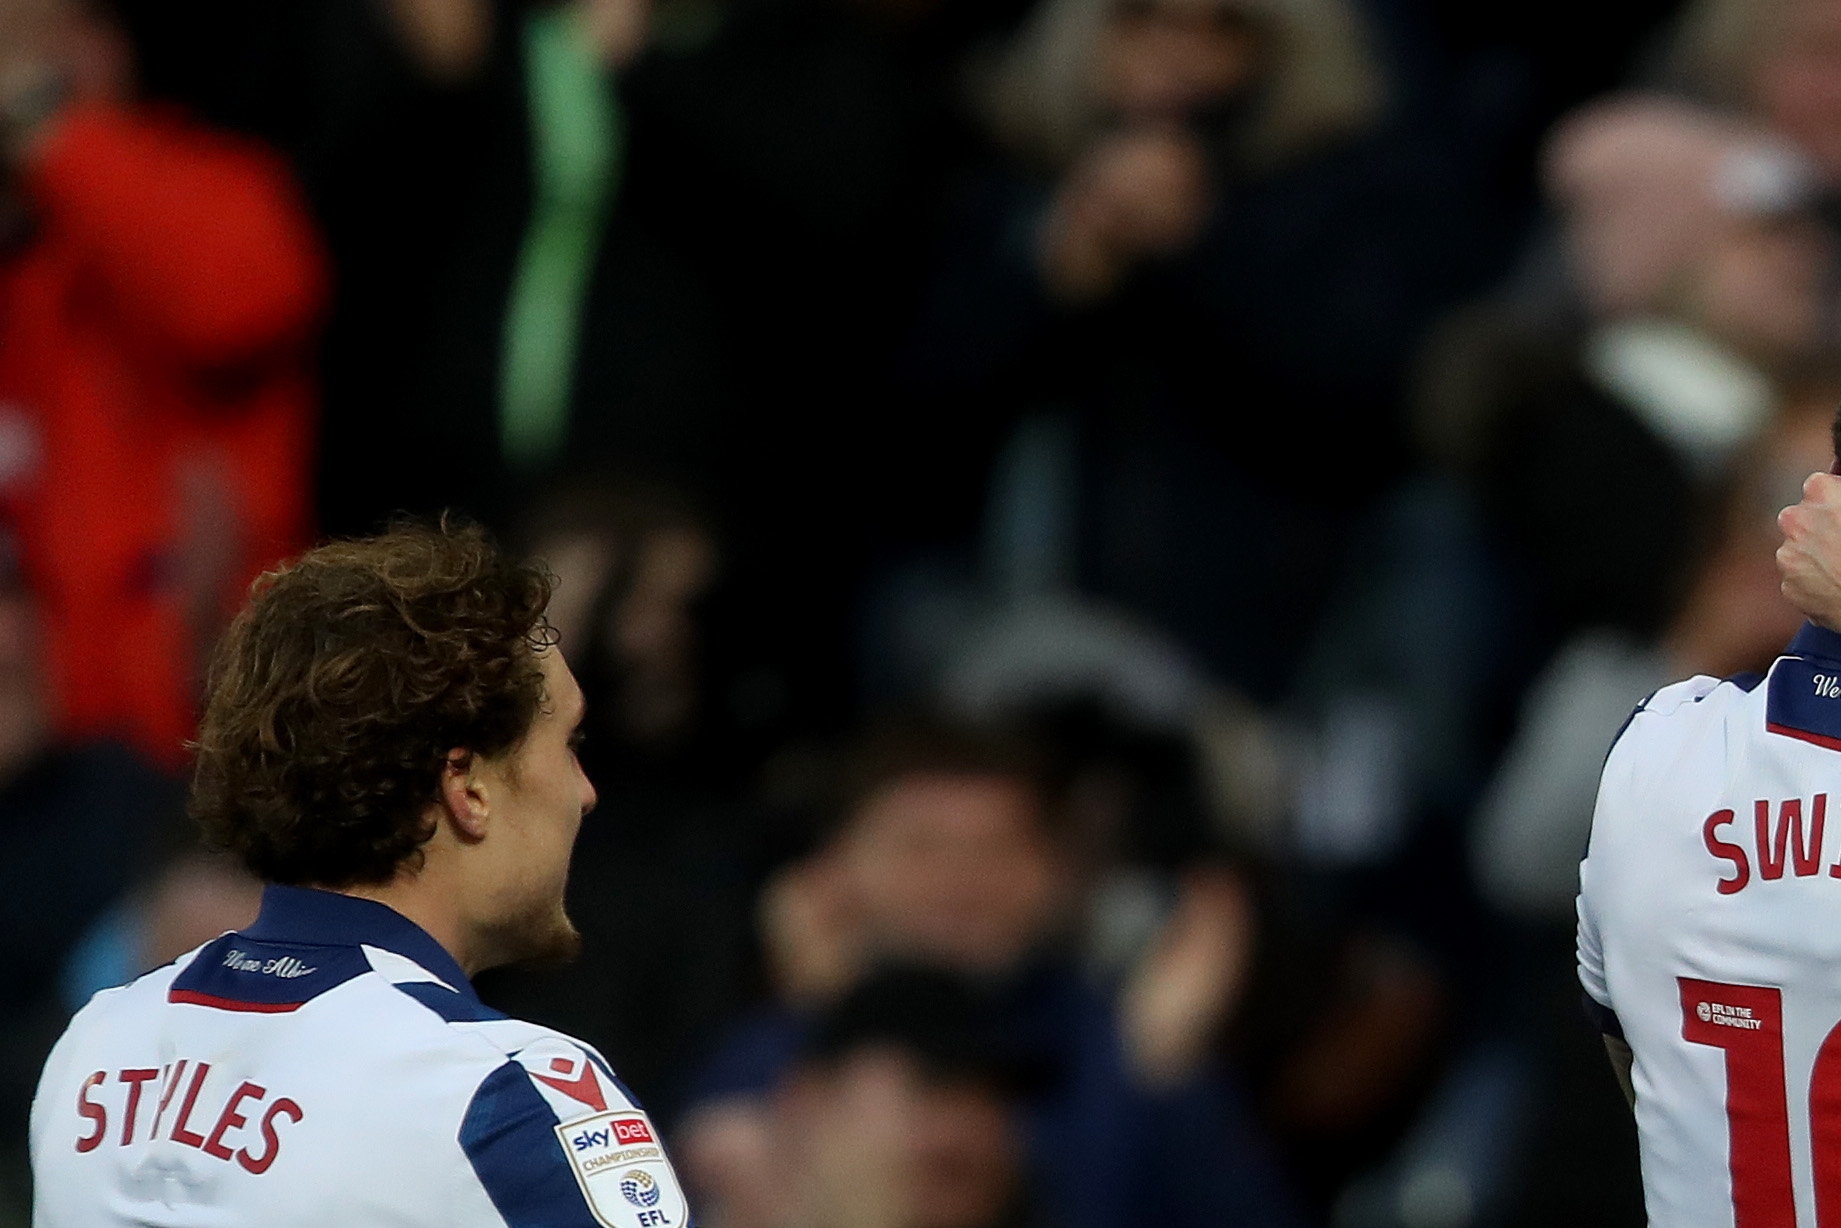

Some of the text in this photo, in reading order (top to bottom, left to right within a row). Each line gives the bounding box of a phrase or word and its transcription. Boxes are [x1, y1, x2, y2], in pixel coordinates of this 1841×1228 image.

[1813, 674, 1841, 698] We
[75, 1058, 304, 1175] STYLES
[573, 1120, 650, 1152] sky bet
[637, 1208, 671, 1228] EFL
